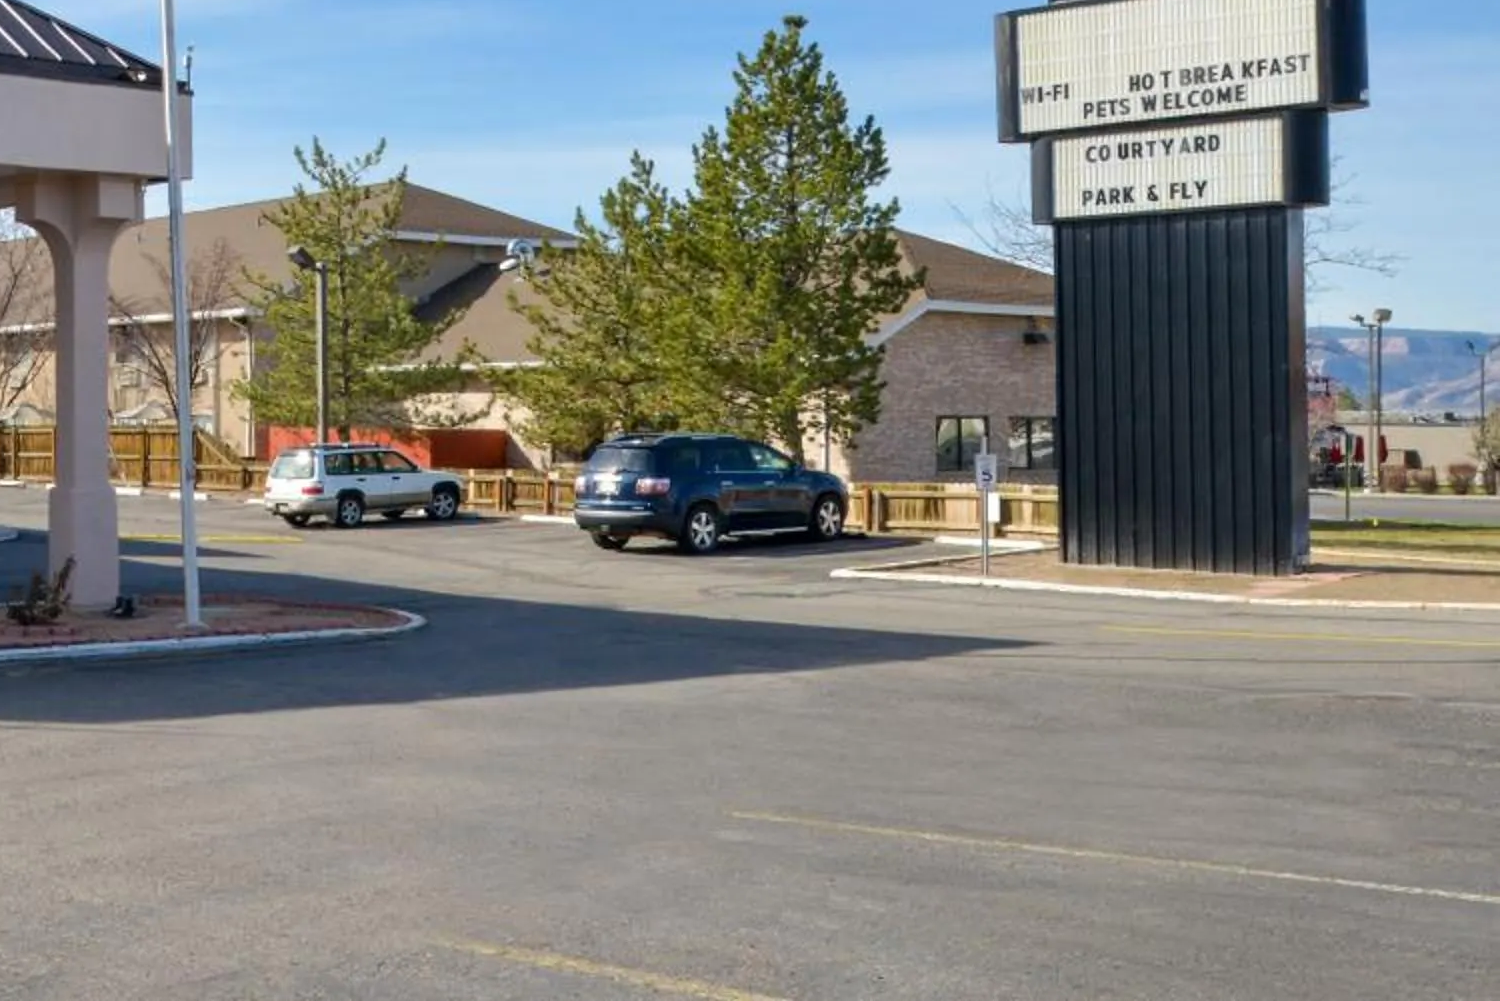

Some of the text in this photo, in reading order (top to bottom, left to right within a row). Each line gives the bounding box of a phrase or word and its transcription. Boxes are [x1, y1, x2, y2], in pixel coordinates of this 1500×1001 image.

[1020, 54, 1311, 104] WI-FI HOT BREAKFAST
[1082, 84, 1247, 119] PETS WELCOME
[1085, 134, 1220, 163] COURTYARD
[1081, 181, 1208, 207] PARK & FLY
